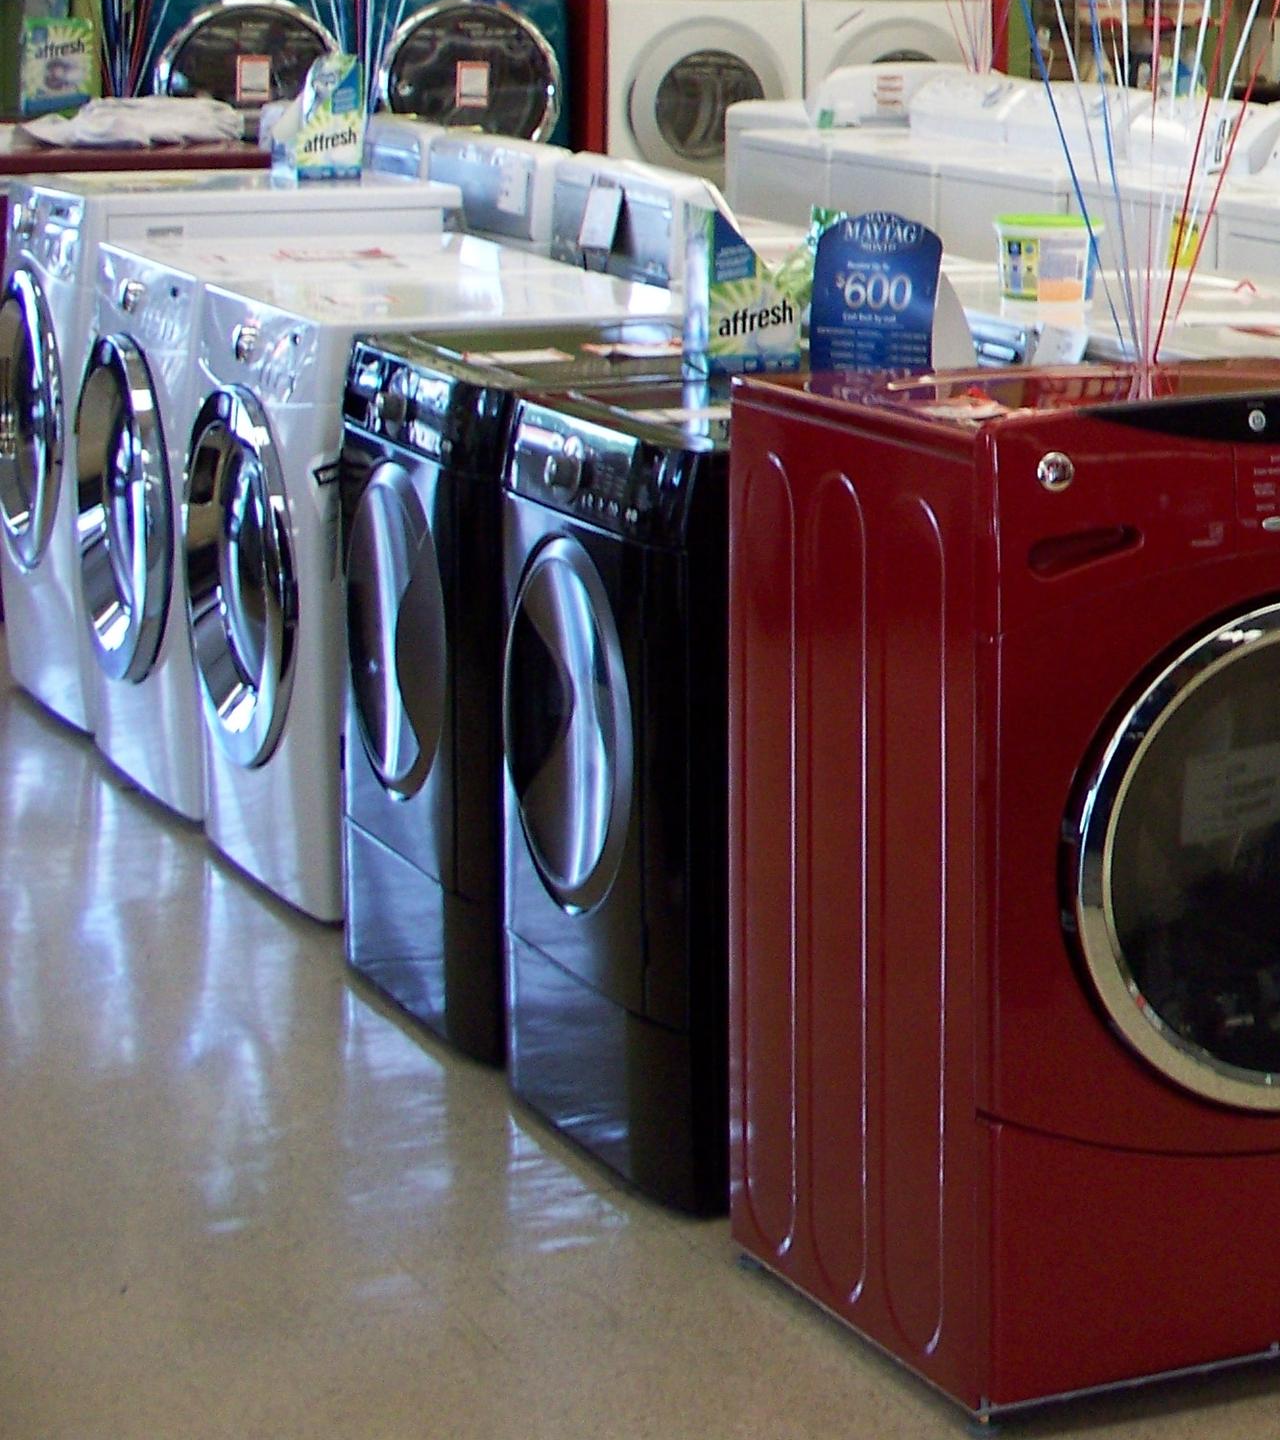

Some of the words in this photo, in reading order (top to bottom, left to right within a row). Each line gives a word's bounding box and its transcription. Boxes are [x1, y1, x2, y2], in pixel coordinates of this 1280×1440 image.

[34, 37, 86, 59] affresh
[304, 126, 358, 153] affresh
[844, 221, 918, 244] MAYTAG
[834, 271, 913, 312] $600
[718, 298, 794, 337] affresh
